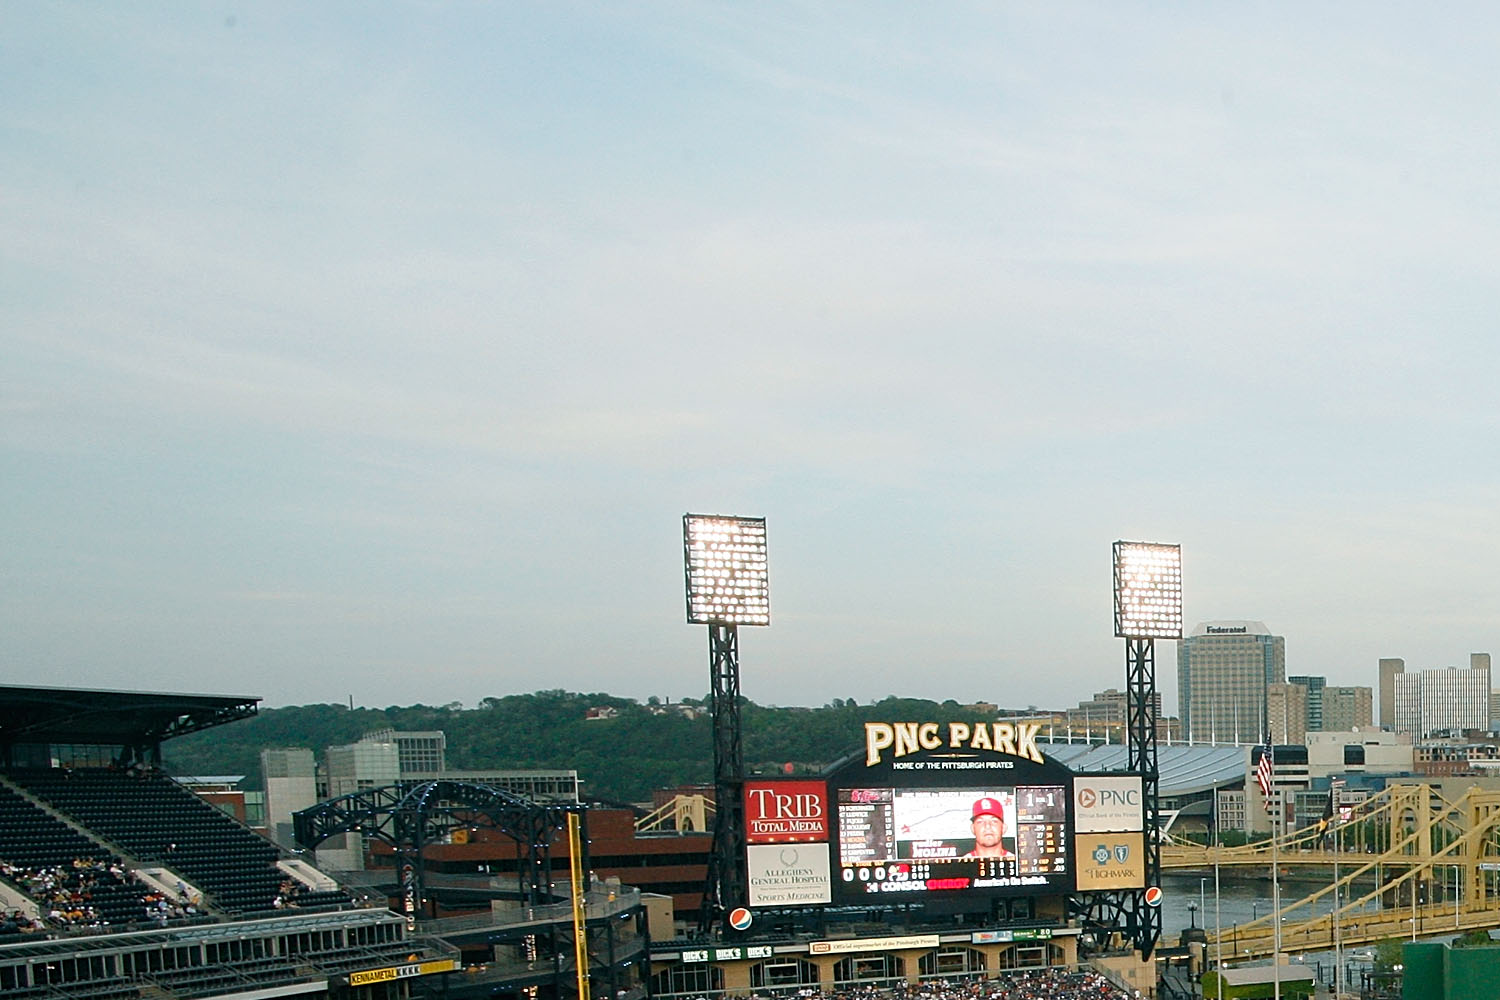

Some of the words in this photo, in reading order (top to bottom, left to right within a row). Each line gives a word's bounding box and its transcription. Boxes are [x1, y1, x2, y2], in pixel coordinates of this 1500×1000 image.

[1206, 625, 1246, 633] Federated
[864, 722, 943, 767] PNC
[949, 722, 1045, 765] PARK
[893, 762, 914, 770] HOME
[915, 762, 925, 770] OF
[927, 762, 940, 770] THE
[941, 762, 985, 770] PITTSBURGH
[985, 762, 1014, 770] PIRATES
[749, 788, 822, 819] TRIB
[1099, 789, 1138, 806] PNC
[751, 820, 788, 832] TOTAL
[789, 820, 823, 831] MEDIA
[764, 868, 814, 877] ALLEGHENY
[843, 868, 854, 881] 0
[859, 868, 870, 881] 0
[874, 867, 886, 880] 0
[1089, 868, 1137, 879] HIGHMARK
[751, 877, 789, 886] GENERAL
[791, 876, 828, 884] HOSPITAL
[881, 881, 927, 892] CONSOL
[757, 894, 785, 902] SPORTS
[683, 950, 708, 963] DICK'S
[716, 947, 741, 961] DICK'S
[747, 945, 772, 958] DICK'S
[351, 969, 396, 984] KENNAMETAL
